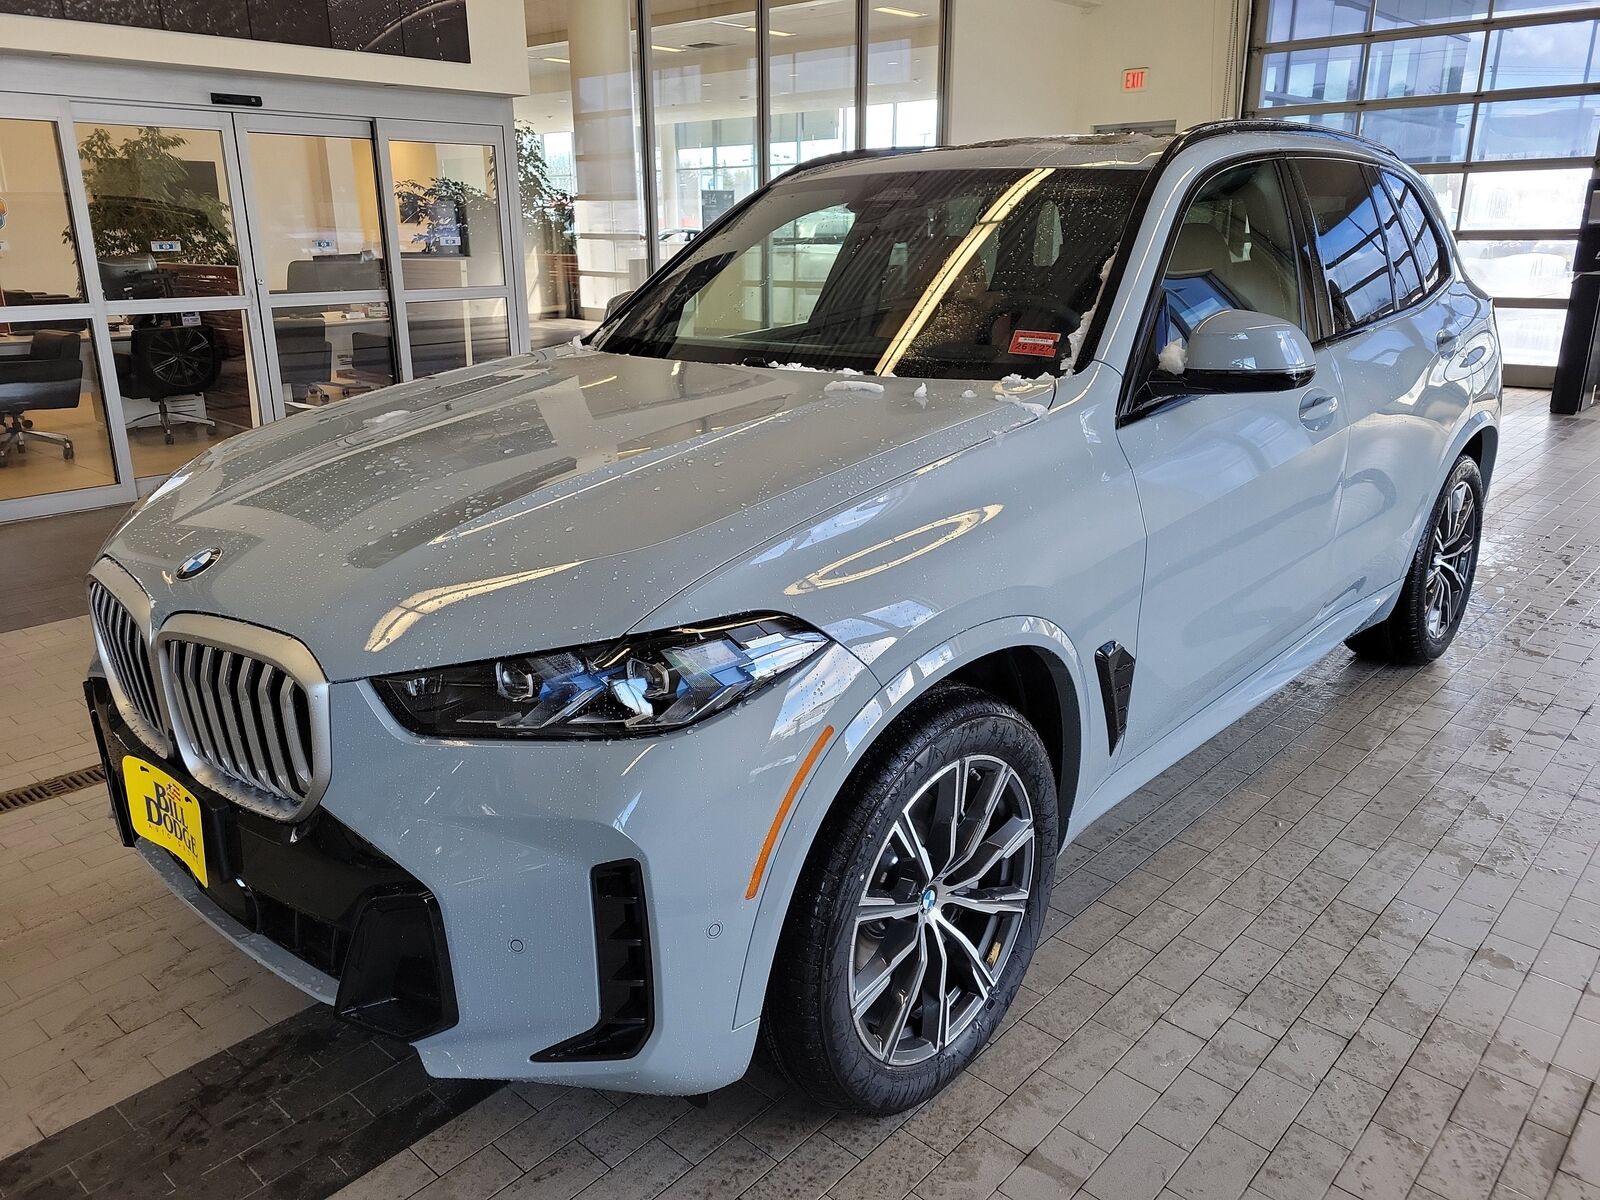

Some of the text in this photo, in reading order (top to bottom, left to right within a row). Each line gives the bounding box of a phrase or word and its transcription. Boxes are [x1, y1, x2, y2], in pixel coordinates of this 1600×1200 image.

[1125, 71, 1144, 88] EXIT
[144, 795, 198, 857] DODGE
[153, 781, 188, 830] BILL
